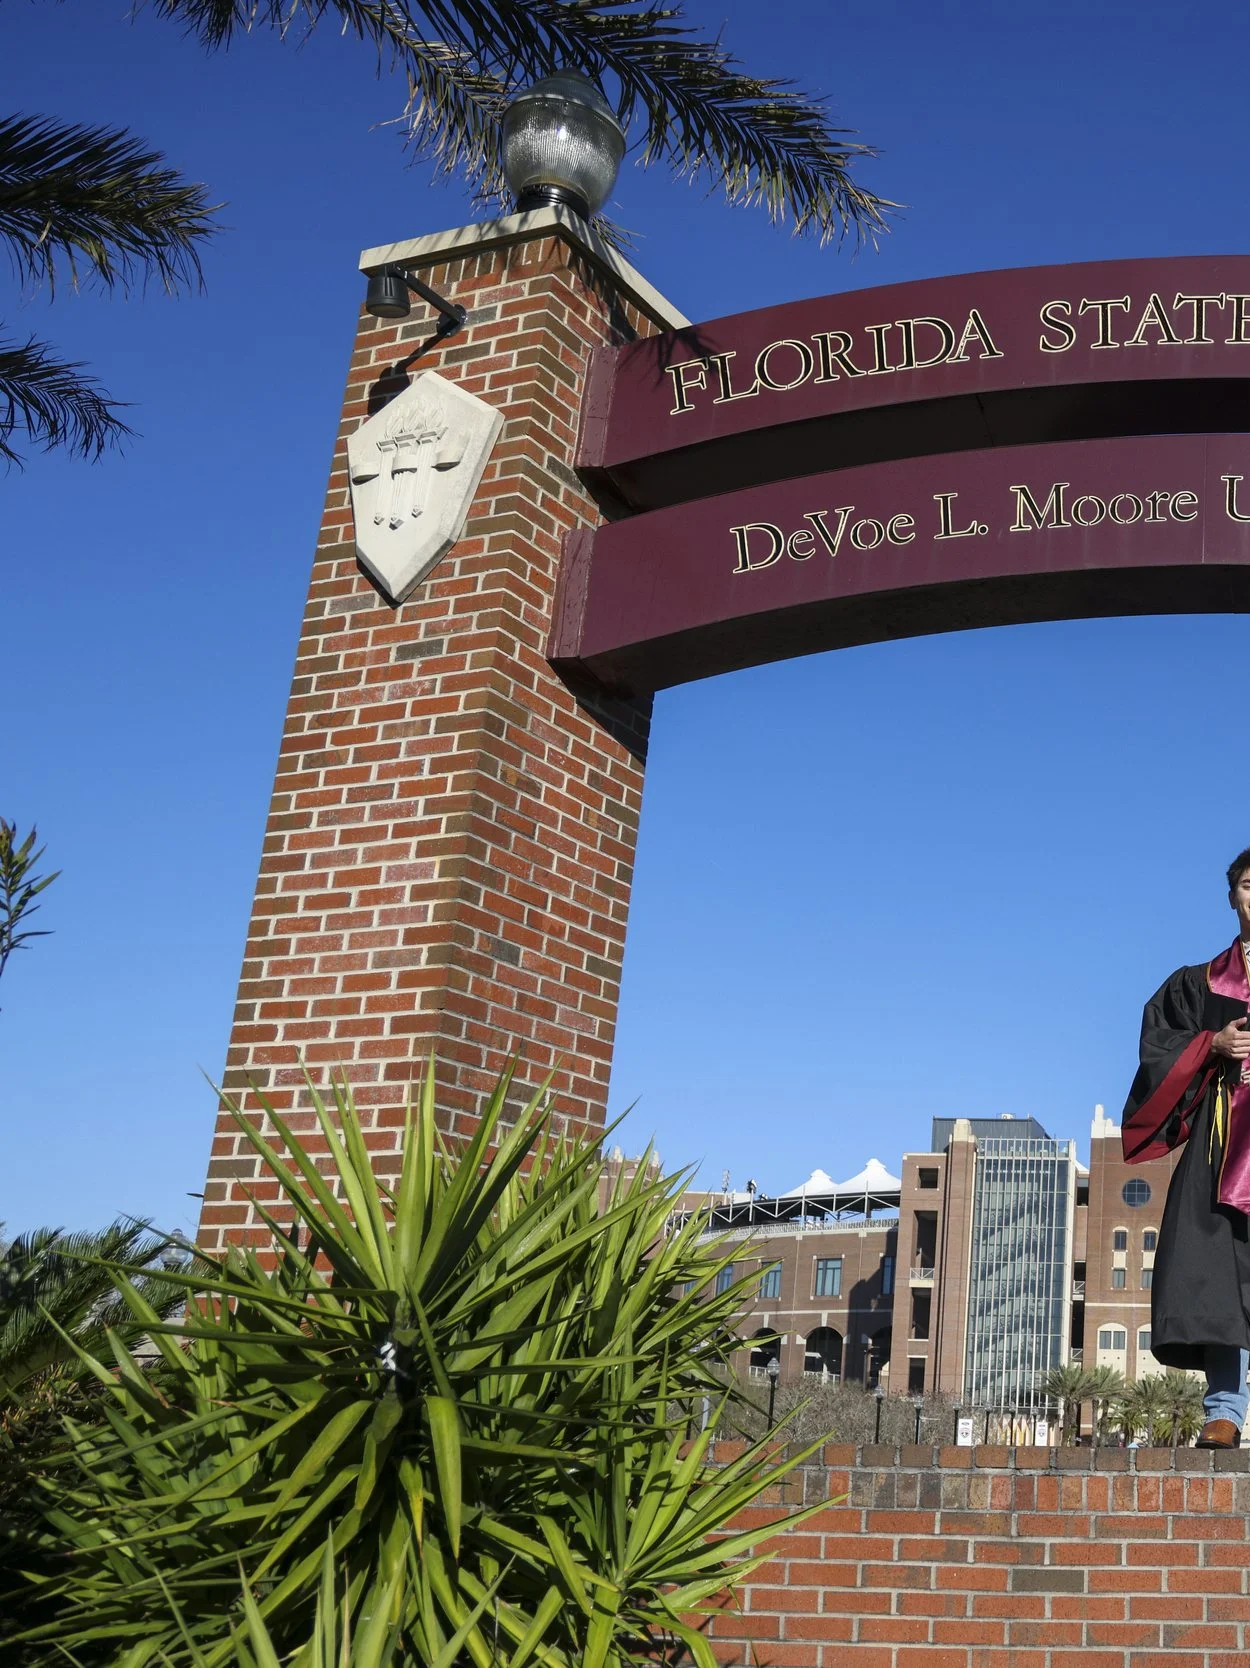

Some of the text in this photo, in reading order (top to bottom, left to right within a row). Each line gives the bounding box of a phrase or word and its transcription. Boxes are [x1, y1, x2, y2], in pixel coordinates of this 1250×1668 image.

[664, 309, 1004, 415] FLORIDA
[730, 506, 916, 574] DeVoe
[933, 493, 988, 540] L.
[1010, 482, 1199, 532] Moore
